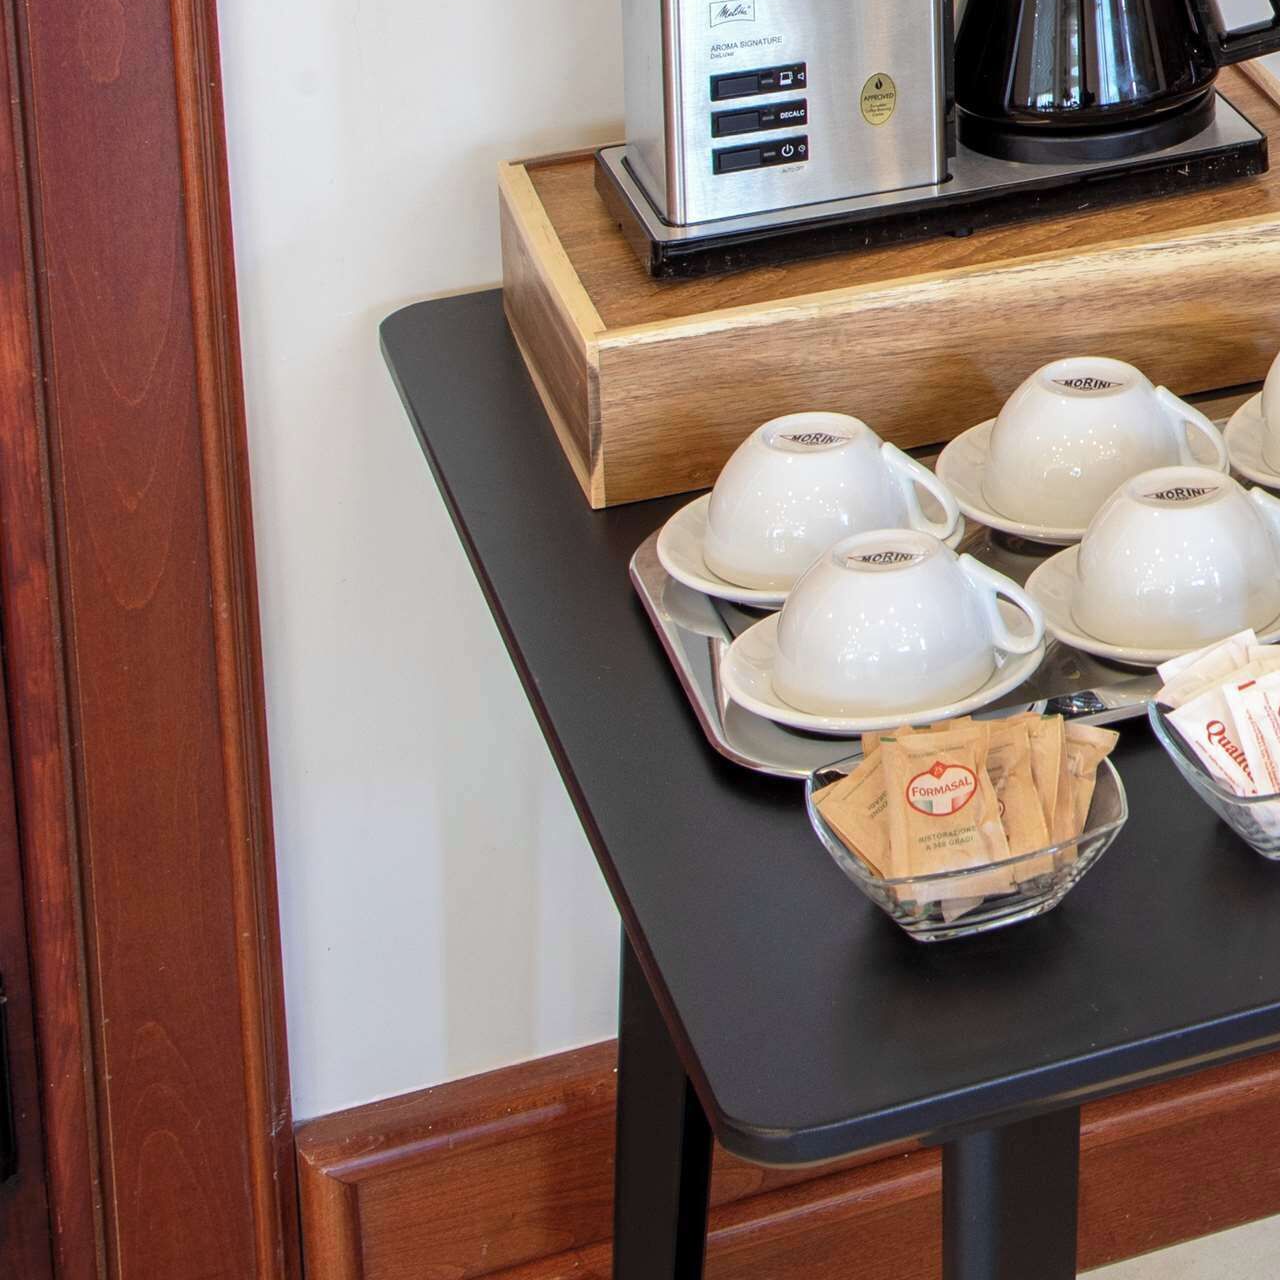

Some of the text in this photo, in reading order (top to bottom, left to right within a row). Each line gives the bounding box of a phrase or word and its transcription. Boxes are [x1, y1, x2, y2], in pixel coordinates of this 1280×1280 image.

[711, 36, 782, 52] AROMA SIGNATURE
[780, 109, 805, 119] DECALC
[1064, 377, 1111, 389] MORINI
[792, 432, 840, 444] MORINI
[1155, 487, 1205, 500] MORINI
[862, 551, 913, 562] MORINI
[1205, 719, 1256, 788] Qualit
[912, 776, 972, 797] FORMASAL
